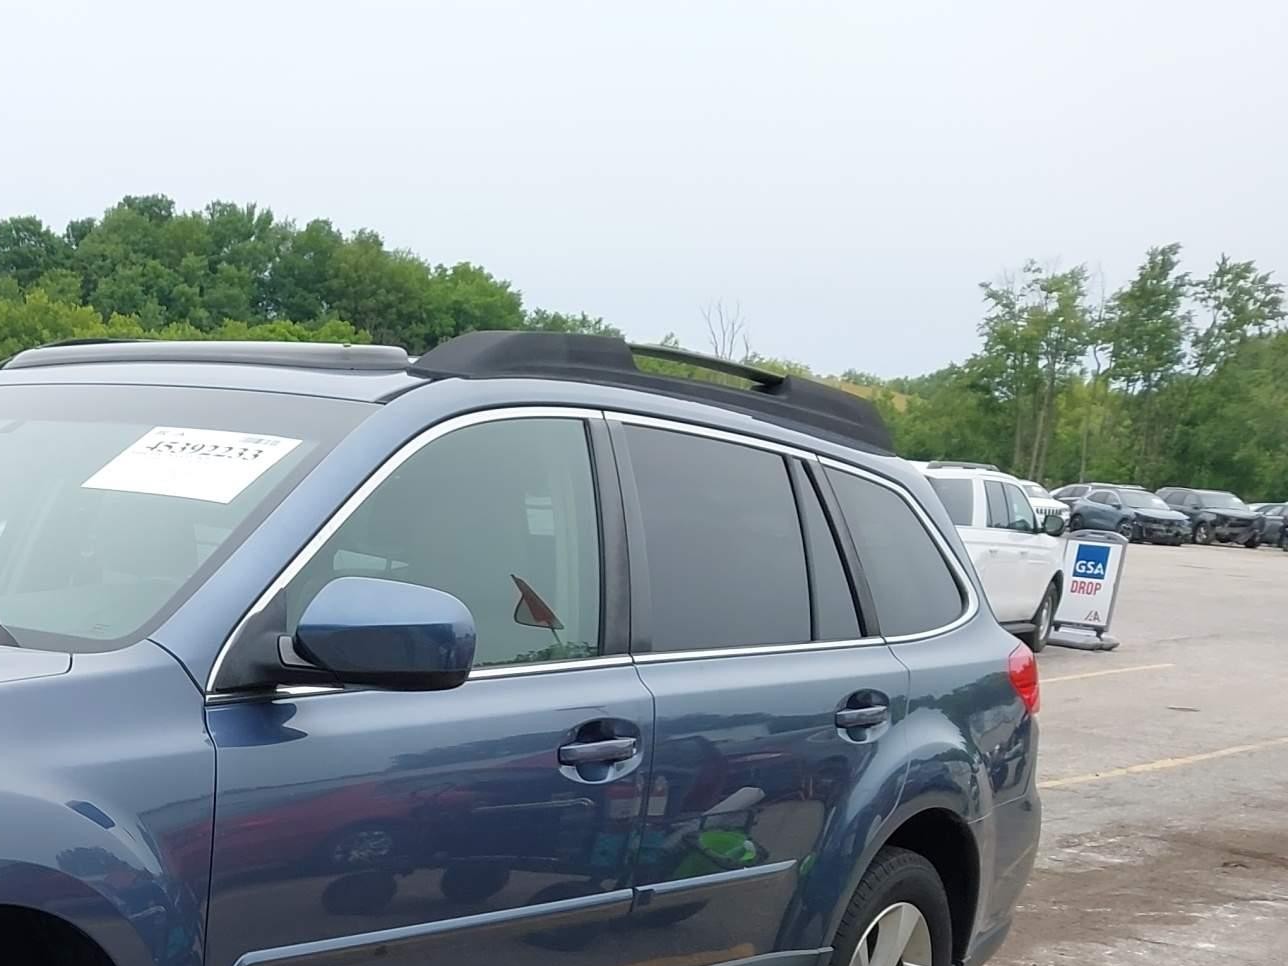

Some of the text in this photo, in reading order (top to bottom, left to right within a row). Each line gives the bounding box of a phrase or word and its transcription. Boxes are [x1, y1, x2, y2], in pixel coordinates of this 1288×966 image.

[145, 441, 264, 461] 45392233
[1075, 560, 1105, 575] GSA
[1070, 580, 1102, 596] DROP
